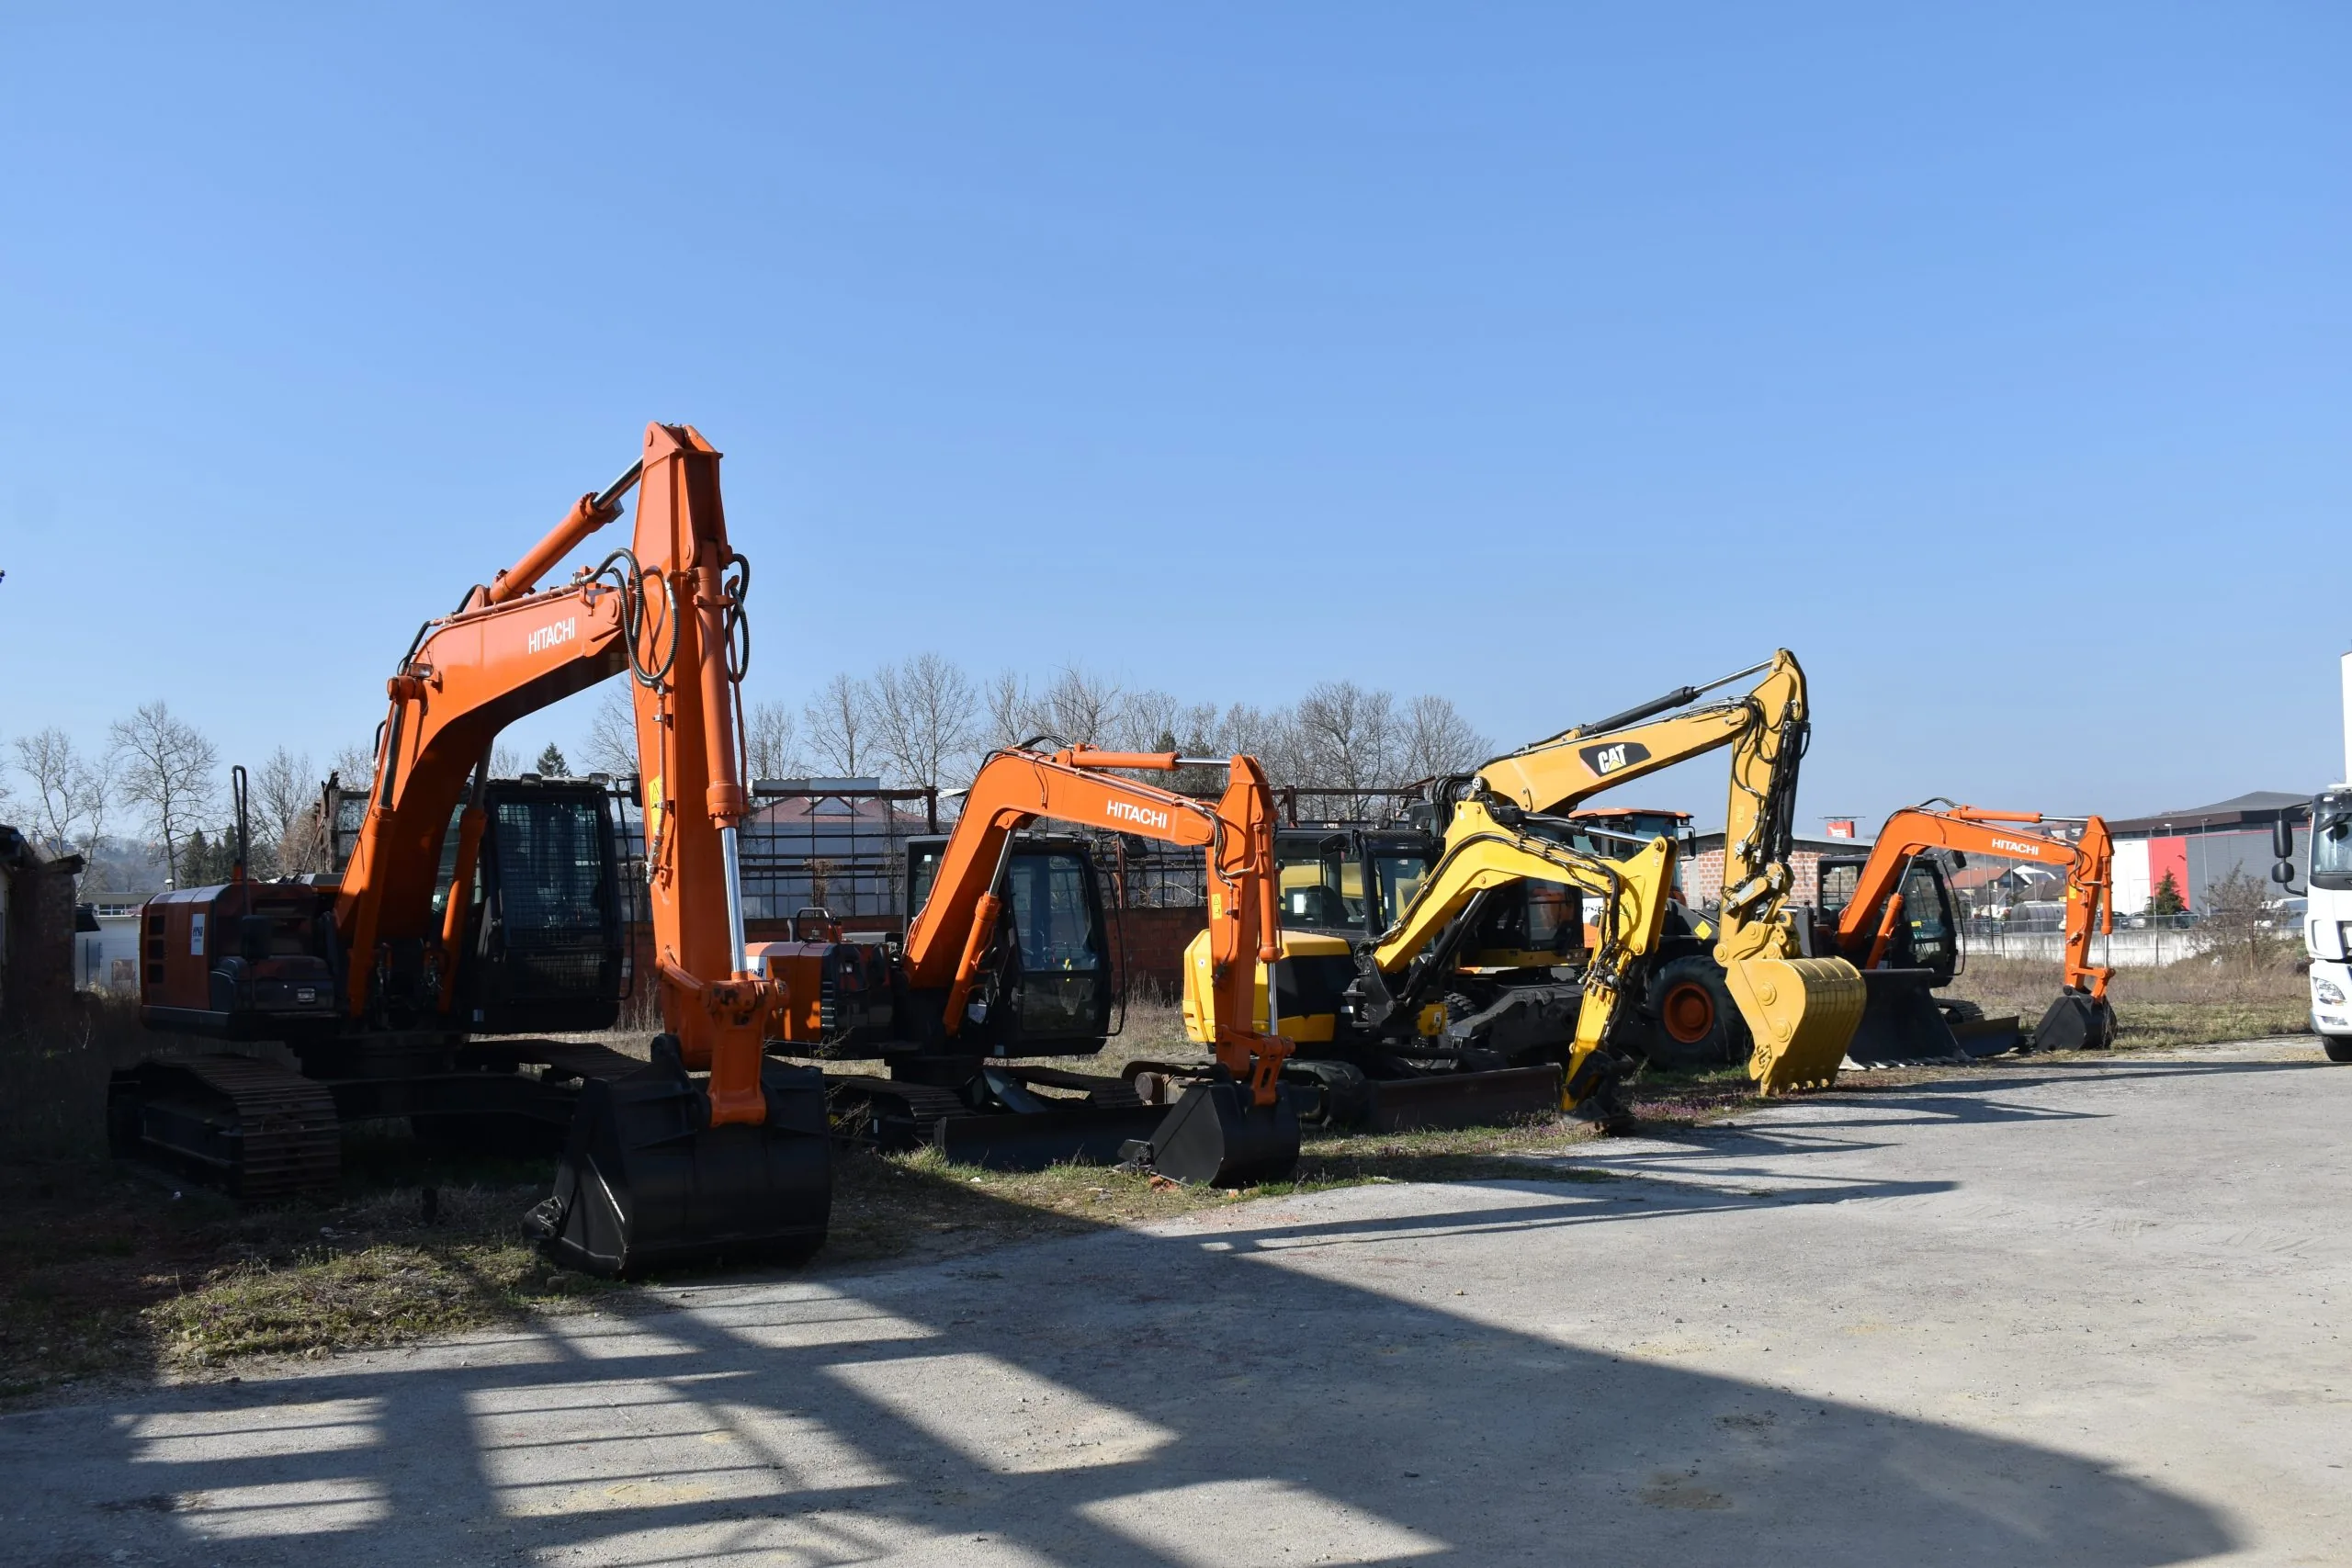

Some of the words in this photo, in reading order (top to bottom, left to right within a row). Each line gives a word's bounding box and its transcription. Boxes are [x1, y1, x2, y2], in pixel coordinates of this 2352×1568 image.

[528, 616, 575, 654] HITACHI
[1598, 744, 1626, 773] CAT
[1106, 799, 1168, 829] HITACHI
[1991, 838, 2039, 855] HITACHI
